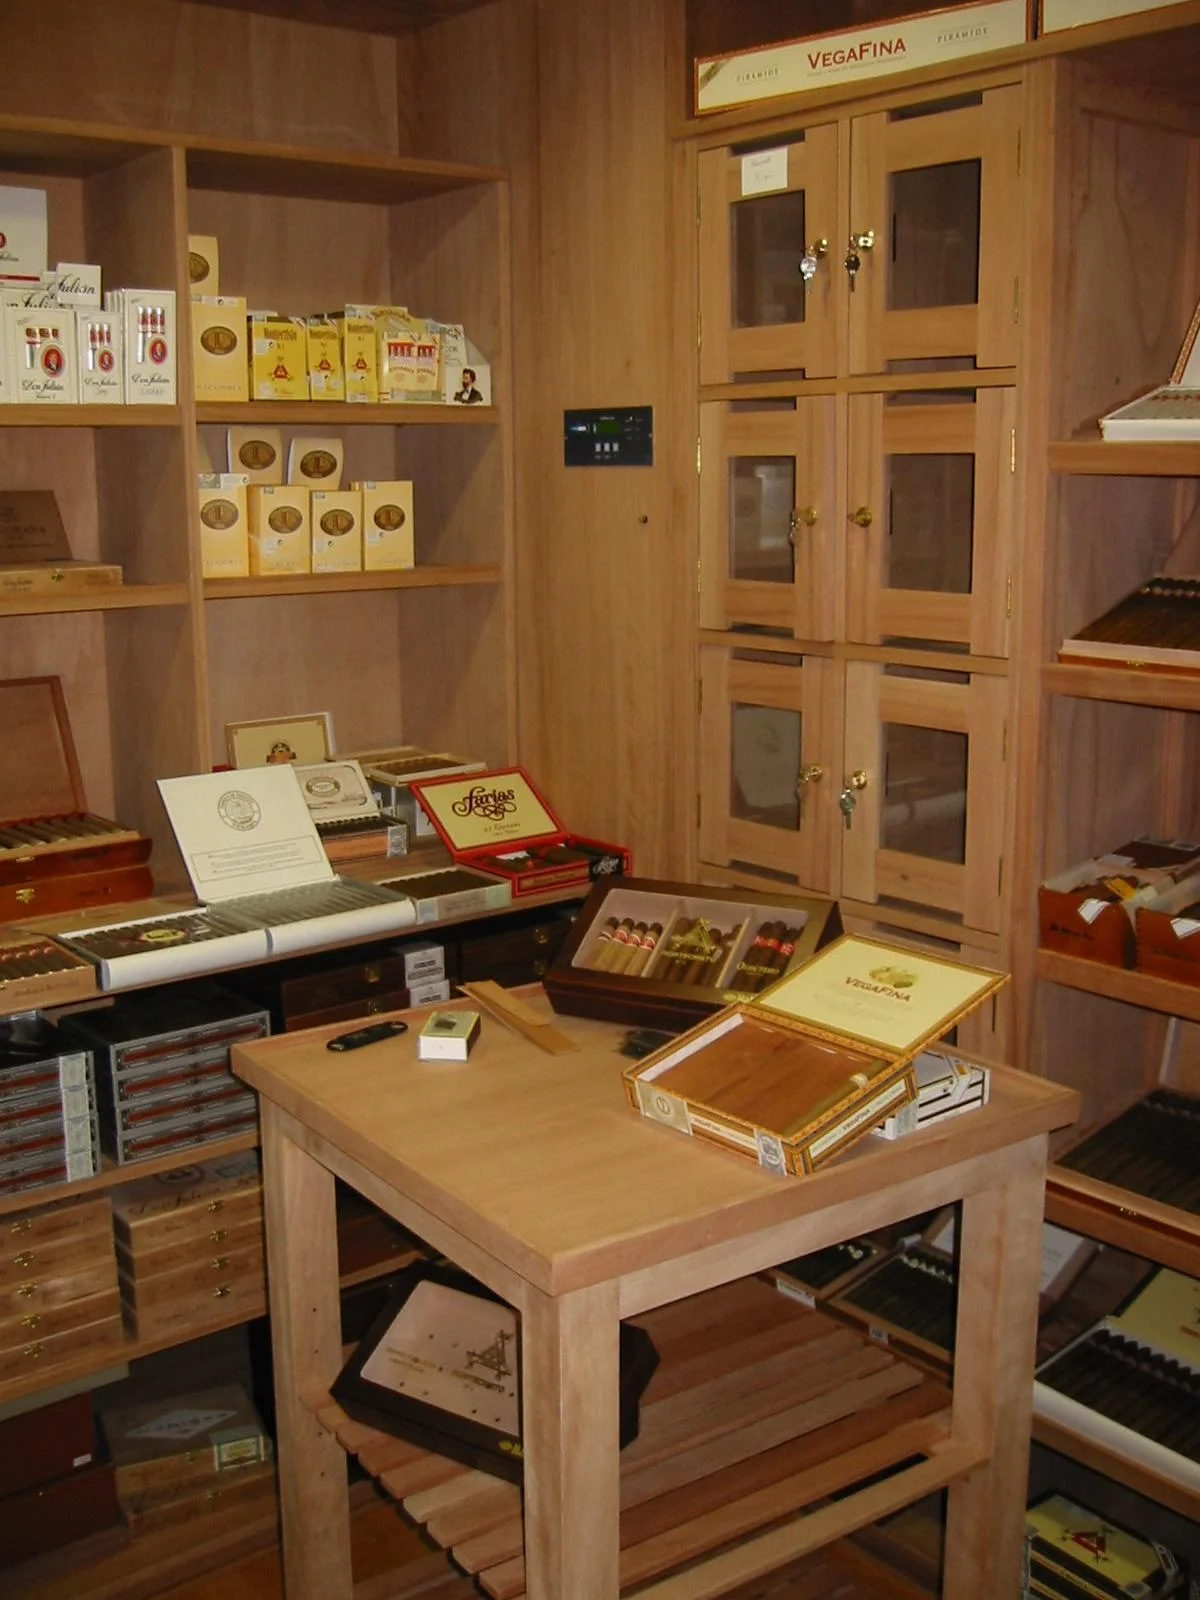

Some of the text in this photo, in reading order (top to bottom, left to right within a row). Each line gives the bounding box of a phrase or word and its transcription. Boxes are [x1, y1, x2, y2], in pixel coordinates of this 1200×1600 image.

[936, 26, 987, 43] PIRAMIDE
[807, 37, 906, 70] VEGAFINA
[736, 67, 778, 83] PIRAMIDE
[22, 379, 65, 394] Don Julian
[131, 372, 170, 385] Don Julian
[452, 786, 517, 821] Farias
[846, 976, 911, 1002] VEGAFINA
